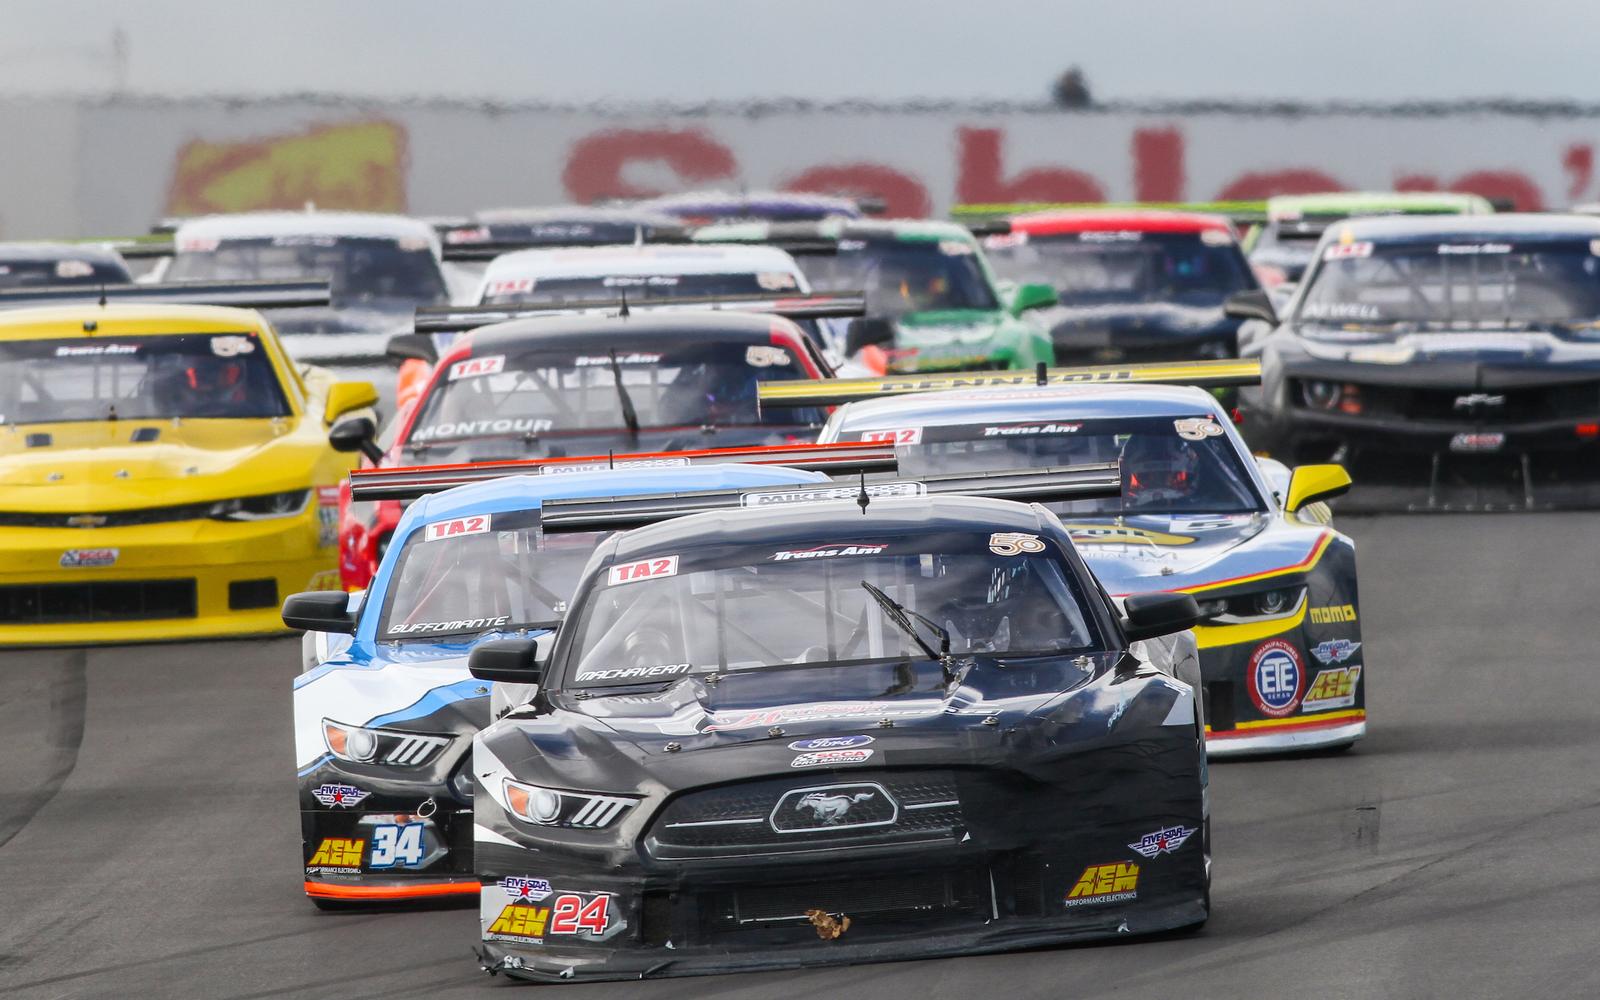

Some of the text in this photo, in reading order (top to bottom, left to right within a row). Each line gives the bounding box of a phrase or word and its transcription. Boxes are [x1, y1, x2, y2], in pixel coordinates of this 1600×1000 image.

[457, 358, 498, 377] TA2
[411, 419, 553, 440] MONTOUR
[984, 424, 1078, 436] Trans Am
[432, 517, 485, 537] TA2
[774, 546, 882, 561] Trans Am
[616, 559, 671, 580] TA2
[388, 615, 510, 634] BUFFOMANTE
[575, 663, 690, 682] MACHAVERN
[1261, 657, 1294, 693] ETE
[1306, 668, 1359, 701] AEM
[808, 737, 855, 749] Ford
[816, 751, 866, 759] SCCA
[321, 785, 360, 798] FIVE STAR
[371, 823, 424, 867] 34
[1143, 827, 1183, 846] FIVE STAR
[307, 838, 365, 866] AEM
[507, 877, 547, 891] FIVE STAR
[1066, 862, 1140, 898] AEM
[1064, 891, 1137, 907] PERFORMANCE ELECTRONICS
[487, 904, 551, 937] AEM
[550, 893, 611, 936] 24
